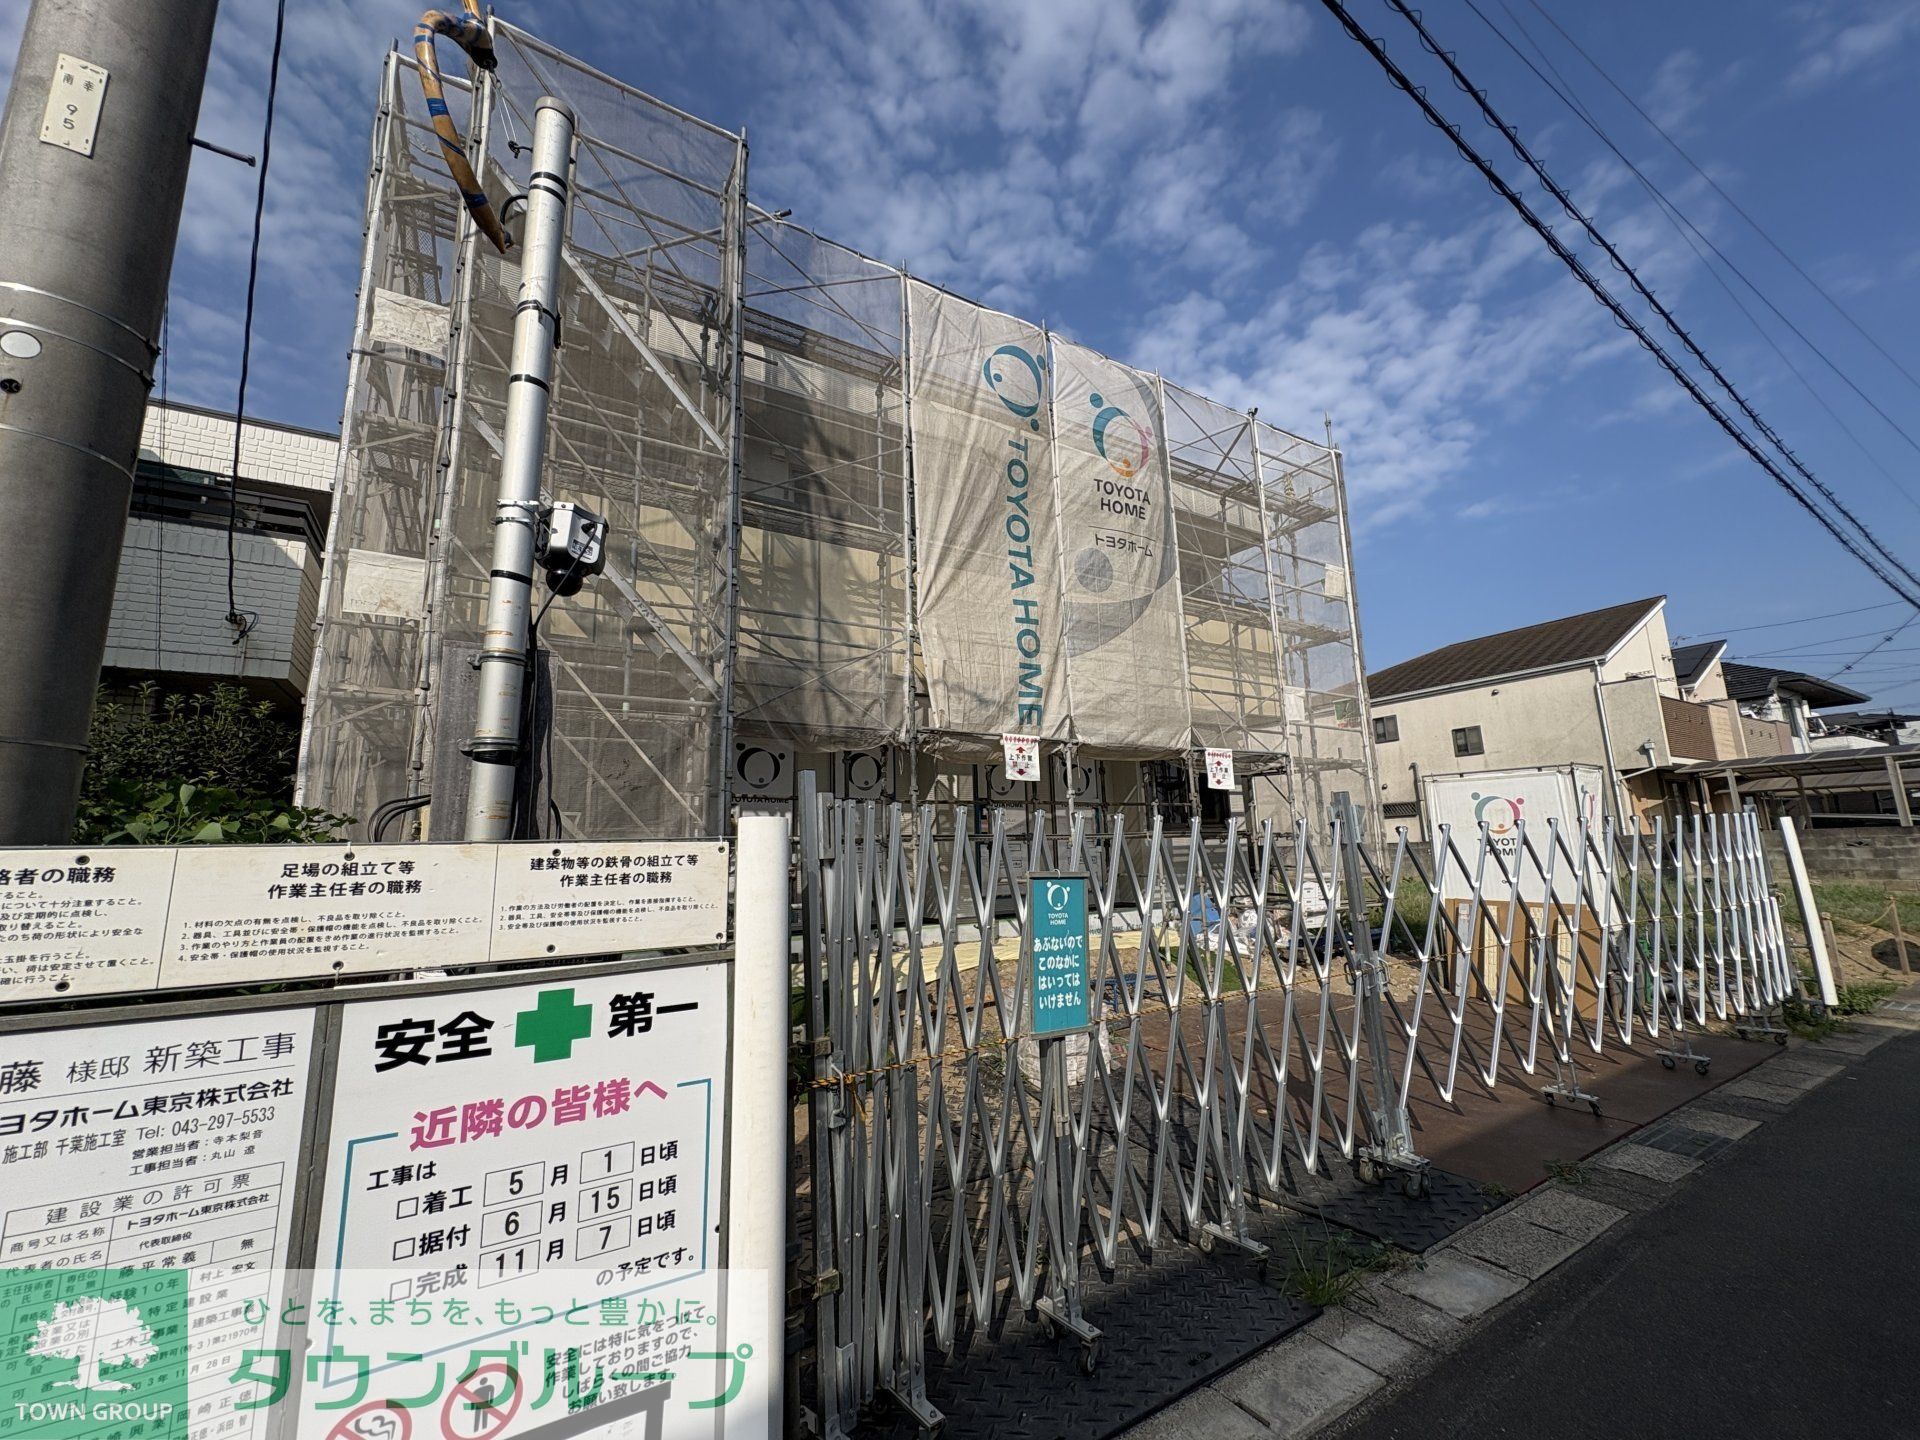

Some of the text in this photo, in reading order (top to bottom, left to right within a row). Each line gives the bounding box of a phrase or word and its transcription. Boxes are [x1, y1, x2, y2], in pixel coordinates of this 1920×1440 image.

[1094, 478, 1151, 505] TOYOTA
[1006, 439, 1035, 590] TOYOTA
[1100, 497, 1145, 520] HOME
[1095, 534, 1153, 557] トヨタホーム
[1012, 598, 1043, 726] HOME
[281, 861, 416, 878] 足場の組立て等
[530, 854, 699, 870] 建築物等の鉄骨の組立て等
[267, 879, 422, 899] 作業主任者の職務
[560, 871, 672, 887] 作業主任者の職務
[0, 891, 43, 899] ること。
[2, 898, 142, 910] について十分注意すること。
[0, 909, 108, 921] 及び定期的に点検し、
[1034, 935, 1083, 952] あぶないので
[1038, 954, 1079, 971] このなかに
[1038, 972, 1080, 990] はいっては
[1039, 991, 1081, 1009] いけません
[374, 991, 698, 1073] 安全 第一
[66, 1056, 130, 1084] 様邸
[143, 1032, 296, 1075] 新築工事
[0, 1078, 293, 1136] ヨタホーム東京株式会社
[409, 1077, 668, 1152] 近隣の皆様へ
[2, 1106, 275, 1164] 施工部 千葉施工室 Tel: 043-297-5533
[367, 1161, 436, 1191] 工事は
[422, 1140, 678, 1215] 着工 5 月 1 日頃
[46, 1173, 250, 1225] 建設業の許可票
[127, 1193, 270, 1230] トヨタホーム東京株式会社
[419, 1174, 677, 1257] 据付 6 月 15 日頃
[416, 1209, 676, 1297] 完成 11 月 7 日頃
[596, 1246, 694, 1286] の予定です。
